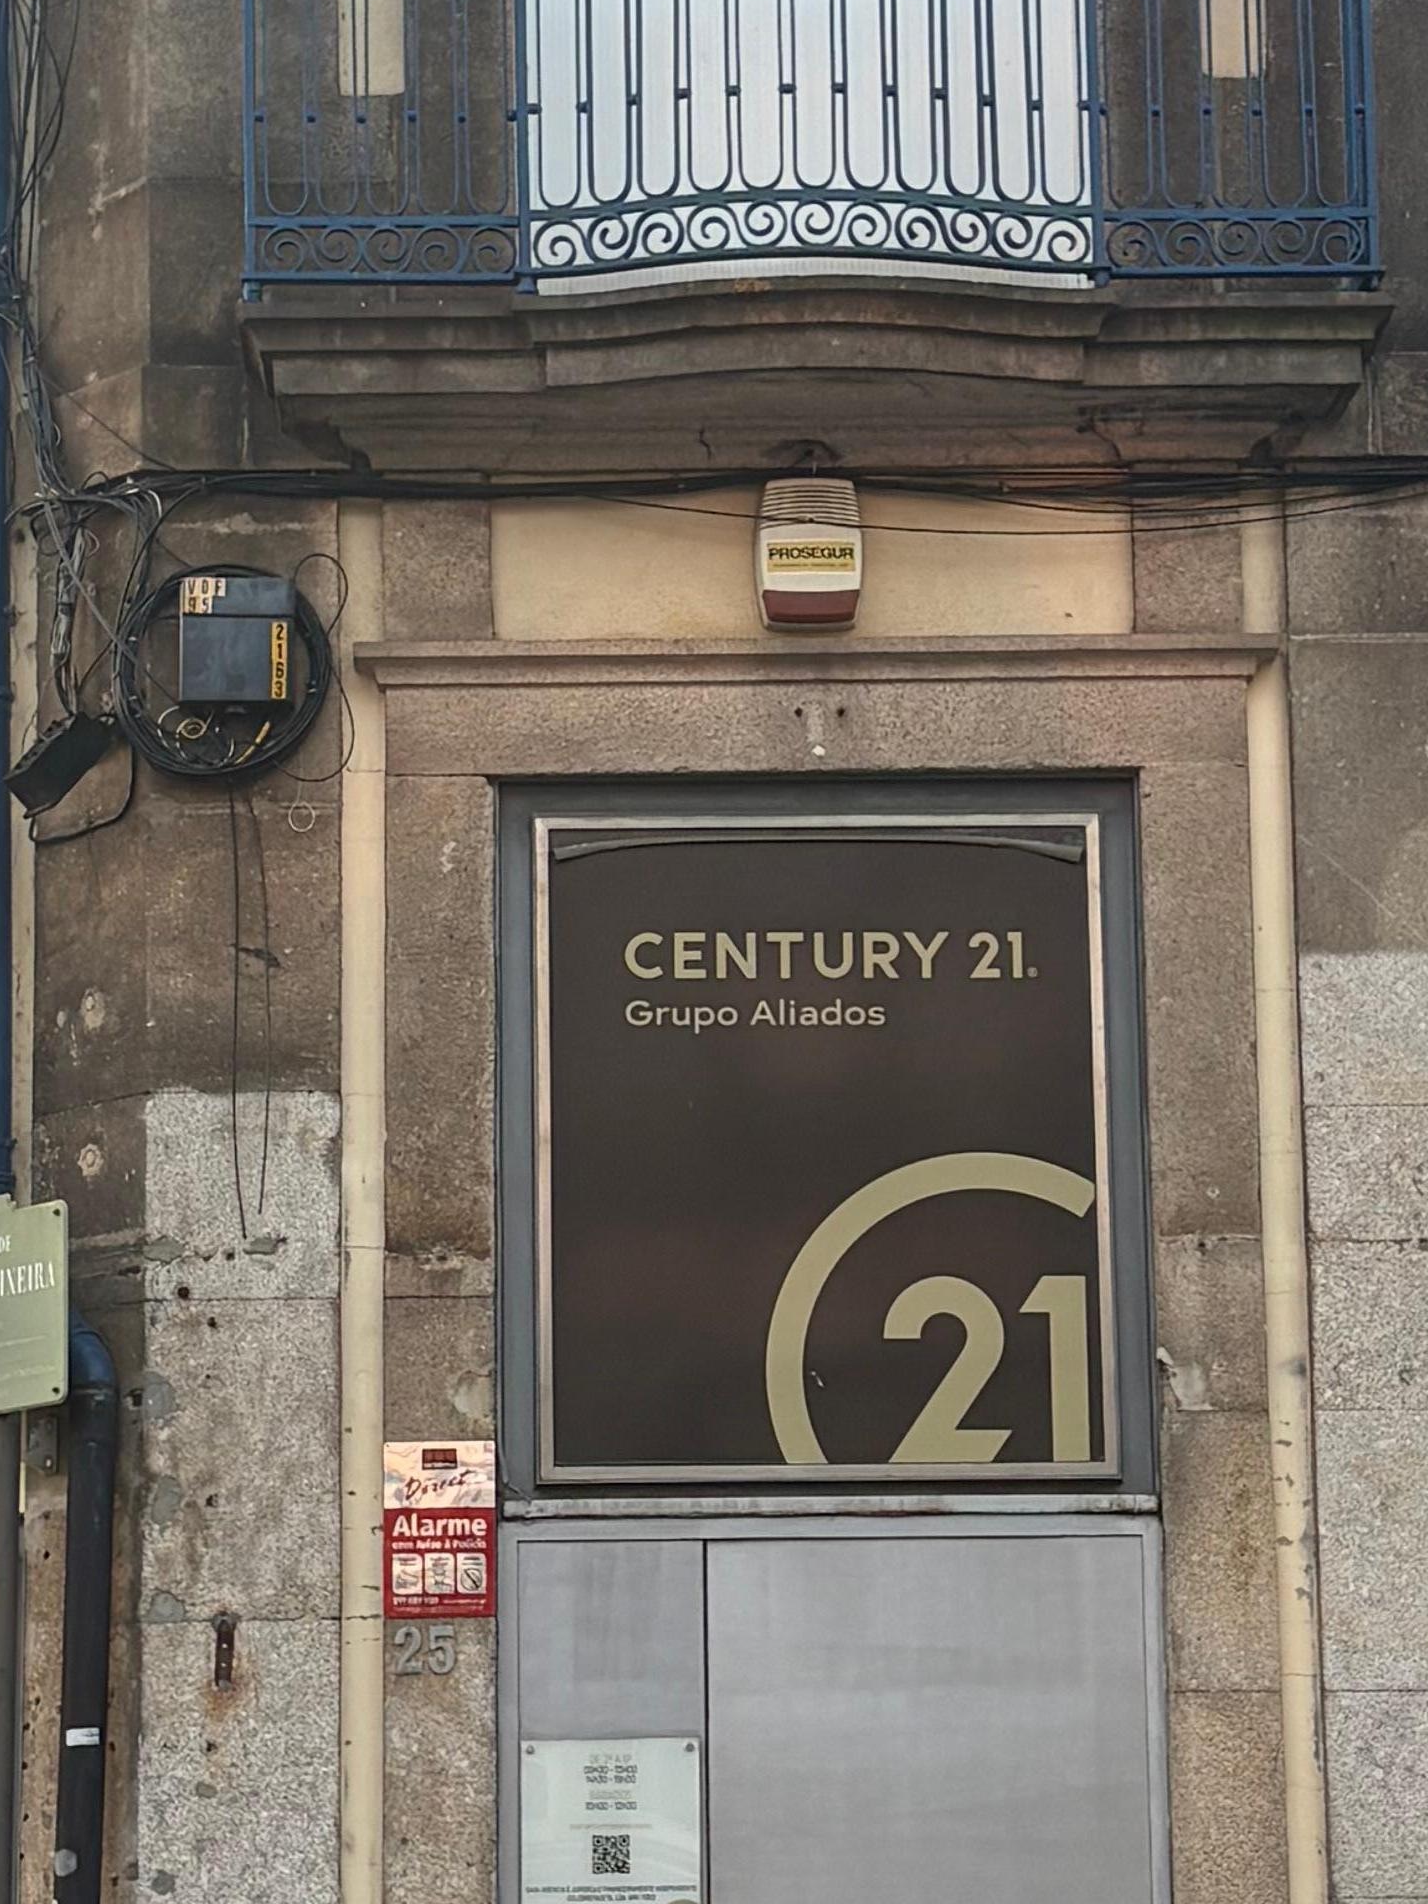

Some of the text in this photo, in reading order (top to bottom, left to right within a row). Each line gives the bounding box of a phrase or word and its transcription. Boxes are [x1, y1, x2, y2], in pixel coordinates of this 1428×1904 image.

[768, 546, 855, 561] PROSEGUR
[274, 623, 285, 698] 2163
[624, 932, 951, 981] CENTURY
[625, 998, 886, 1034] Grupo Aliados
[392, 1514, 487, 1537] Alarme
[394, 1624, 456, 1676] 25
